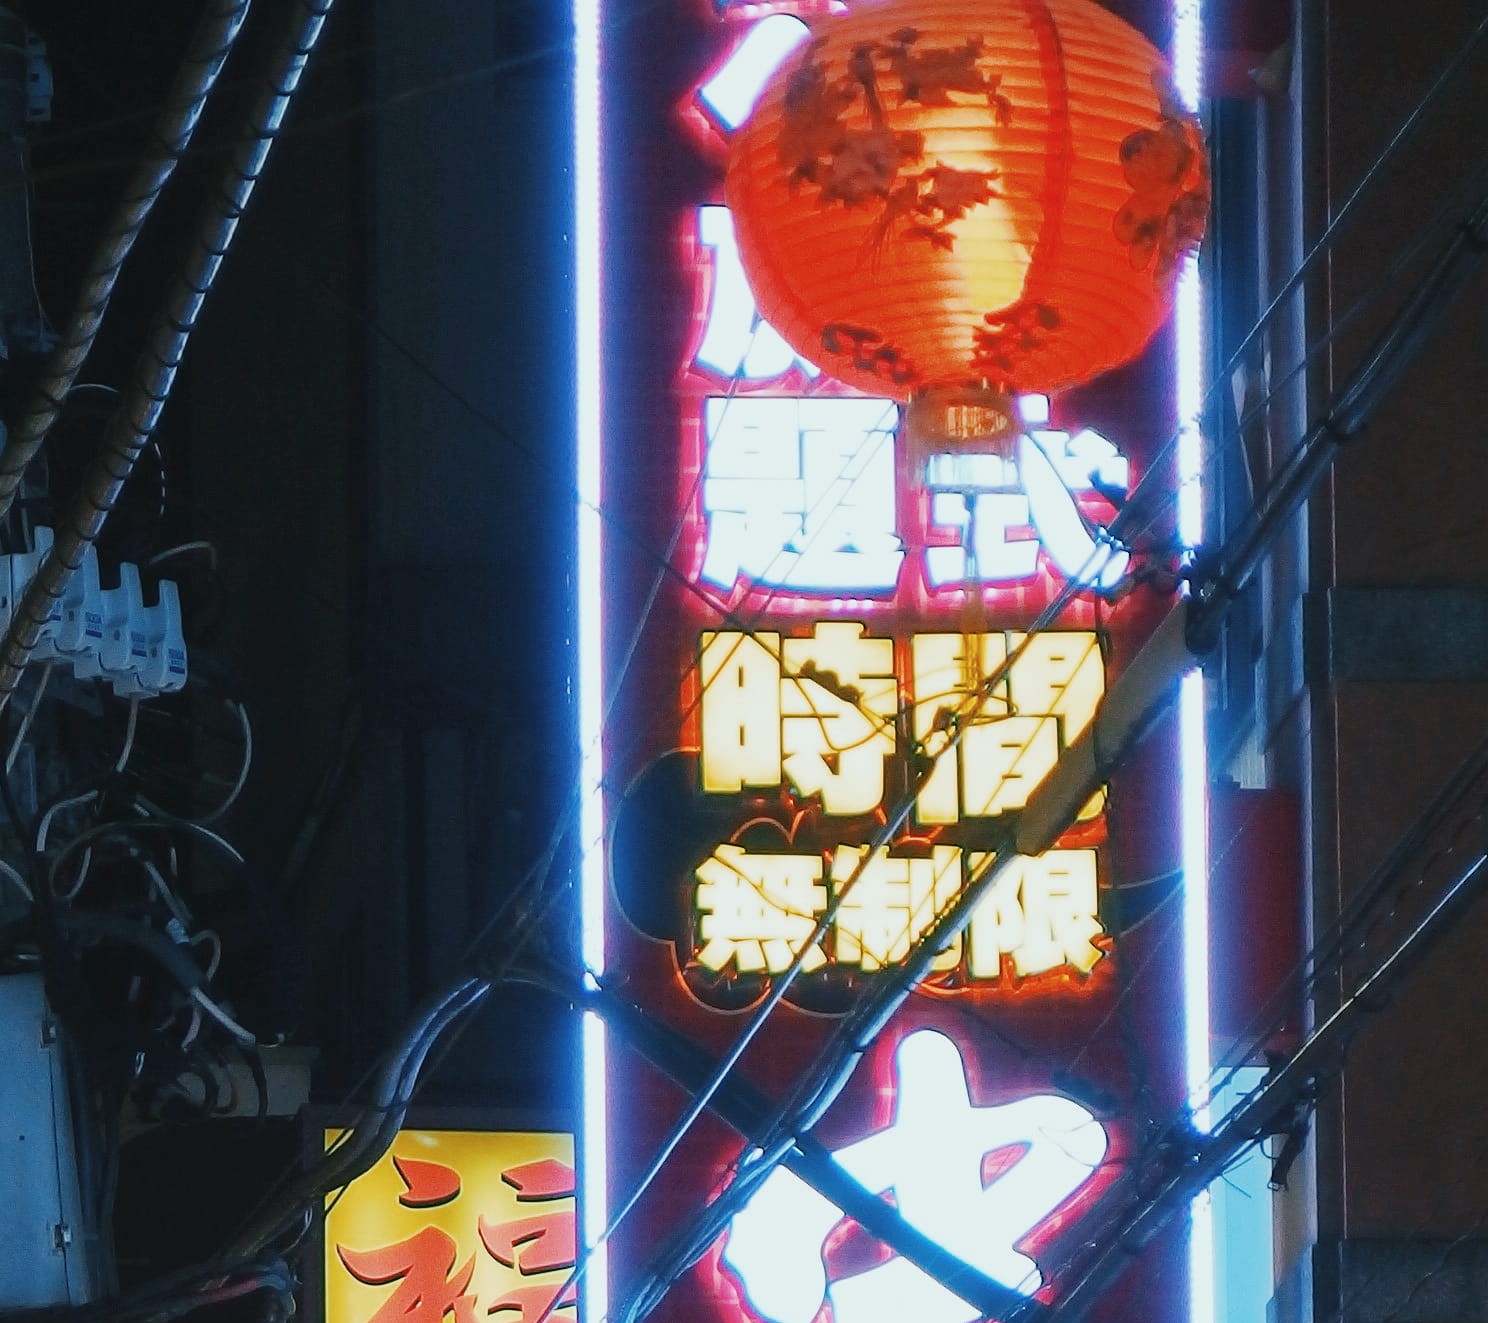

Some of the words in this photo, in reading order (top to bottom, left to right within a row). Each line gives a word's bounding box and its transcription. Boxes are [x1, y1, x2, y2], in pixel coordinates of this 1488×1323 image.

[700, 622, 1107, 824] 時間
[697, 843, 1106, 978] 無制限
